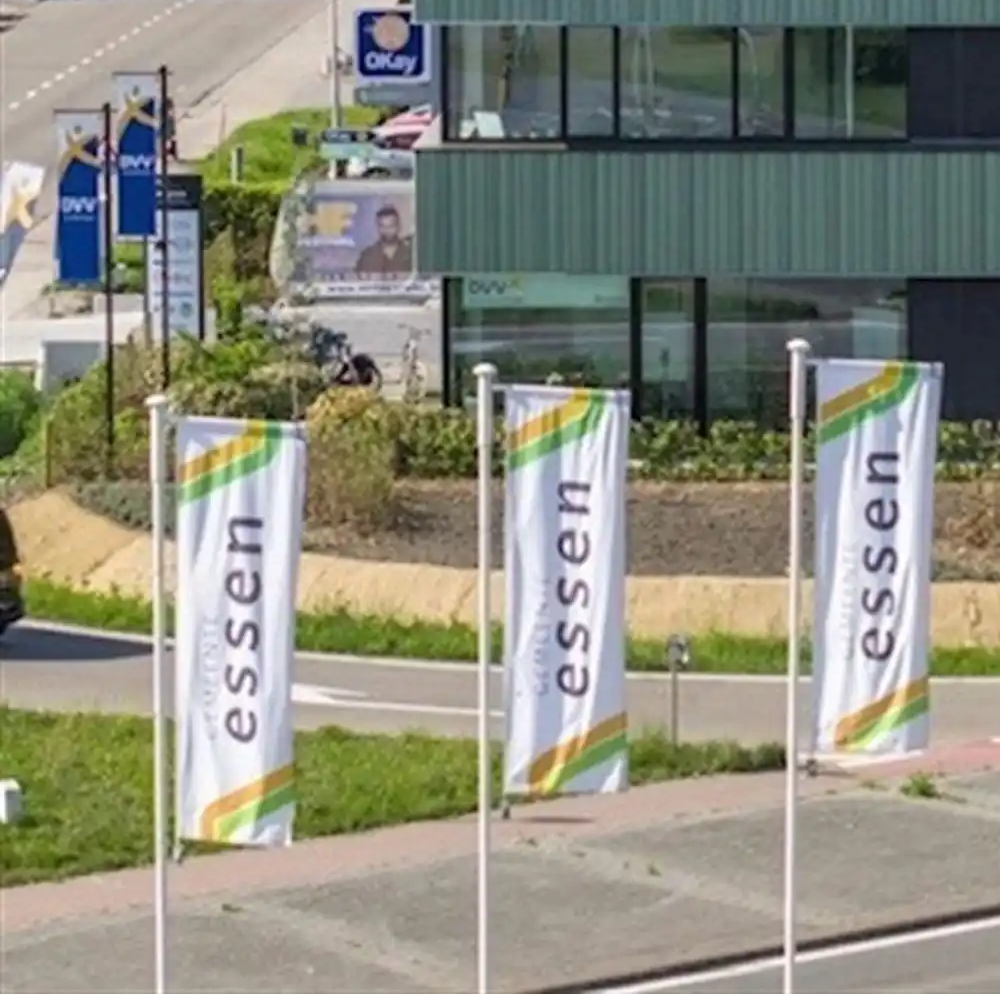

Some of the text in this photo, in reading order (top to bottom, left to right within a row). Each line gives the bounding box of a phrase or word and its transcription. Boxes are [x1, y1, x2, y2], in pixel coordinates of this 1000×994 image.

[364, 51, 418, 75] OKay
[225, 515, 264, 744] essen
[557, 479, 592, 698] essen
[861, 450, 900, 663] essen
